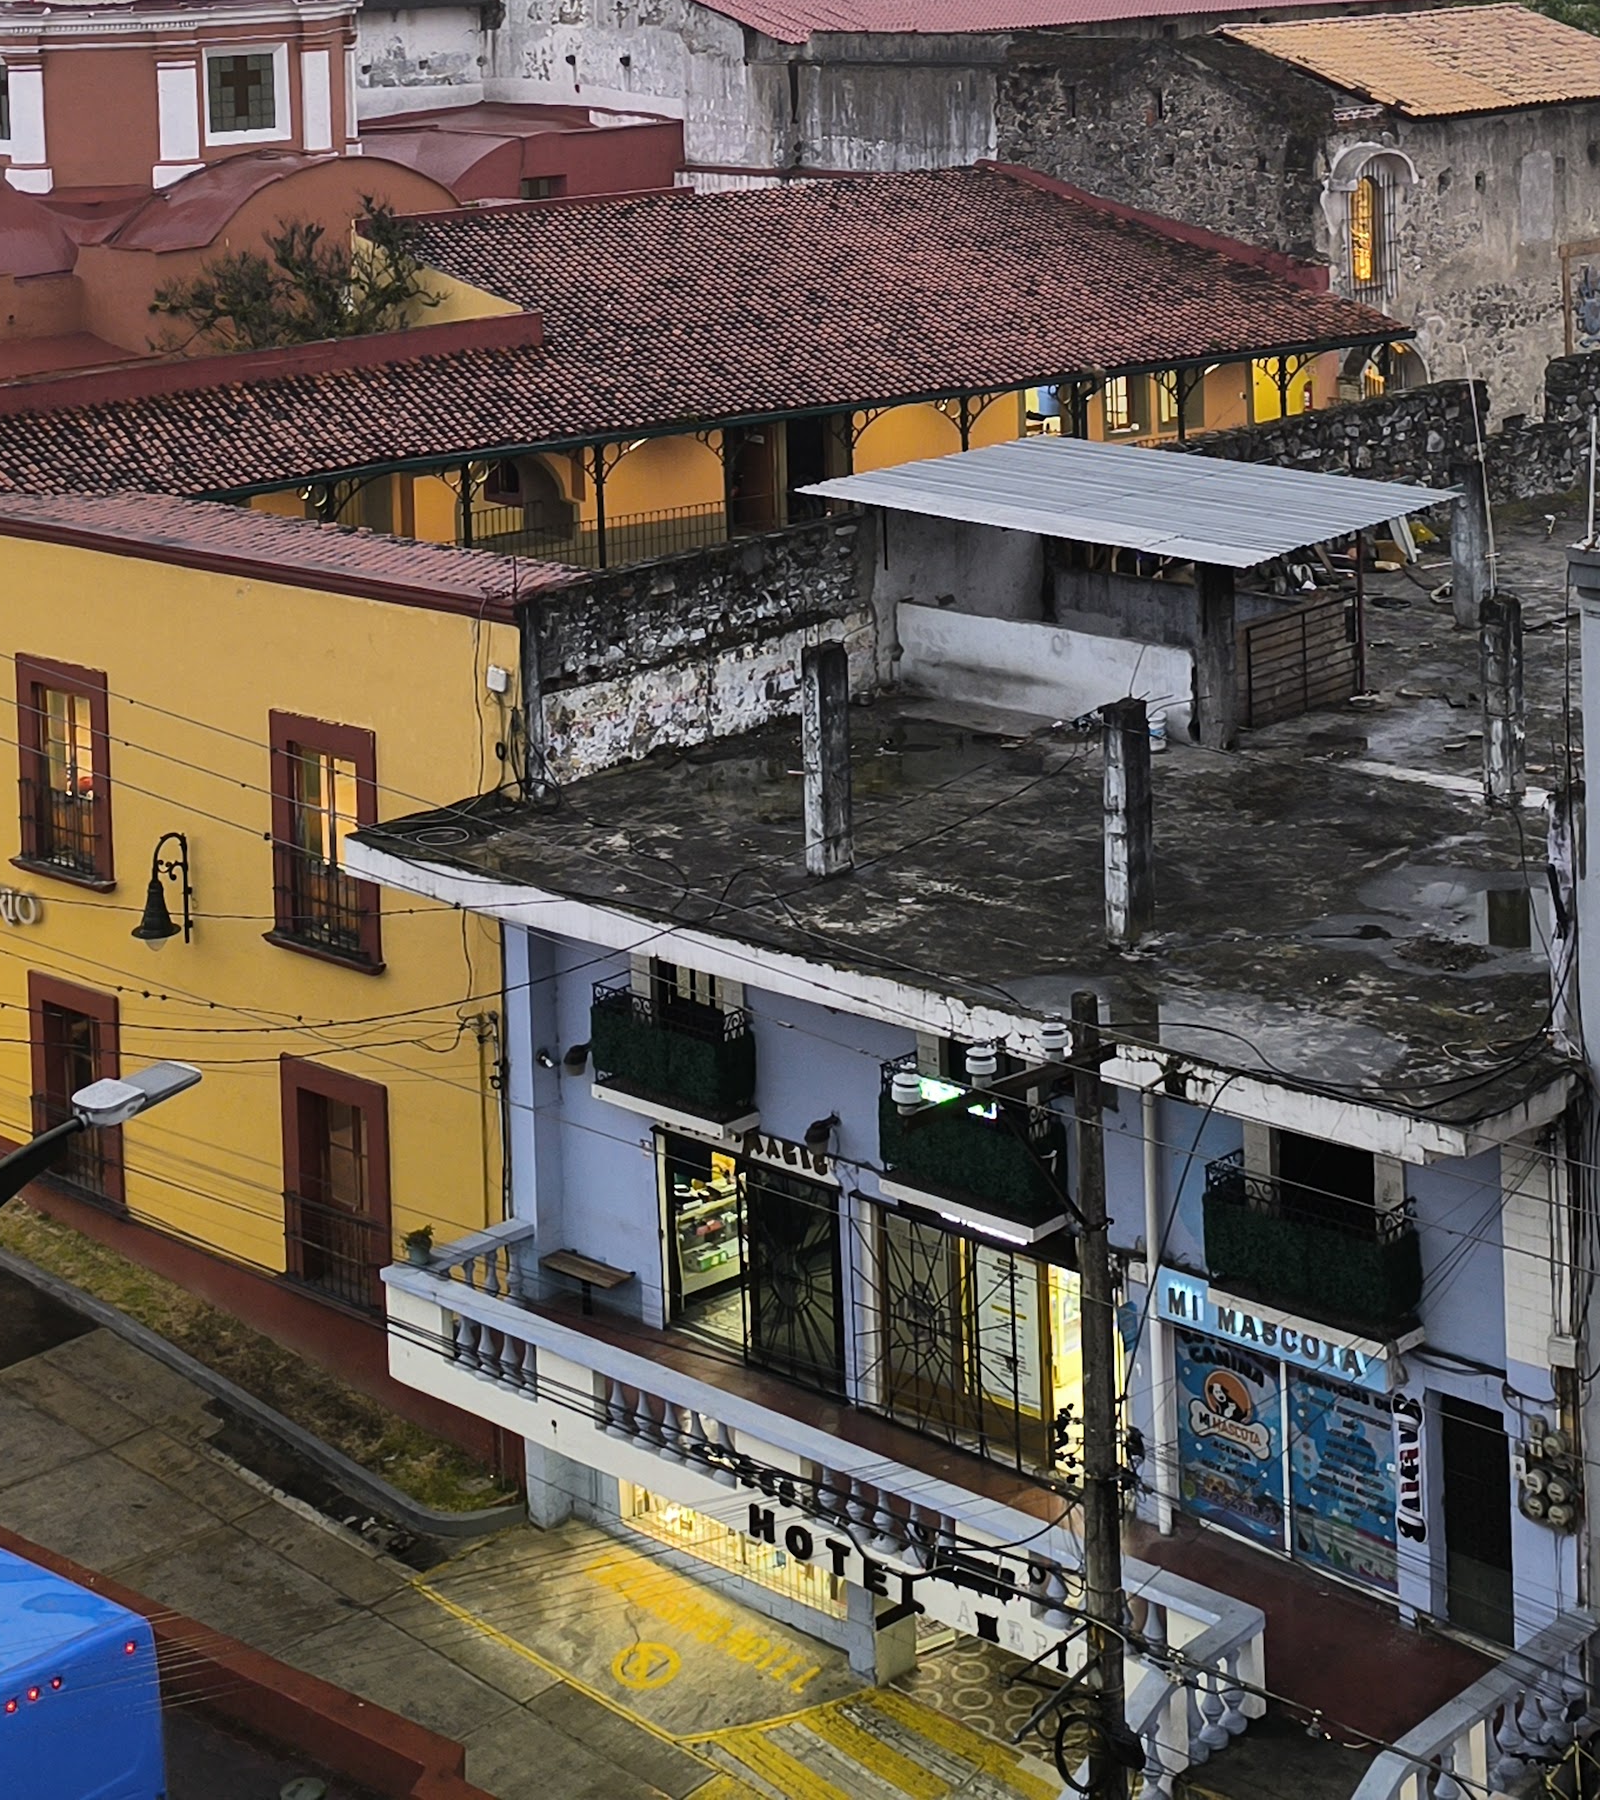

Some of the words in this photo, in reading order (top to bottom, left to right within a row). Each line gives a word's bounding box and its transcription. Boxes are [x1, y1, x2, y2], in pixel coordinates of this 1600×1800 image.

[1167, 1287, 1199, 1322] MI
[1217, 1305, 1362, 1378] MASCOTA
[748, 1502, 925, 1631] HOTEL
